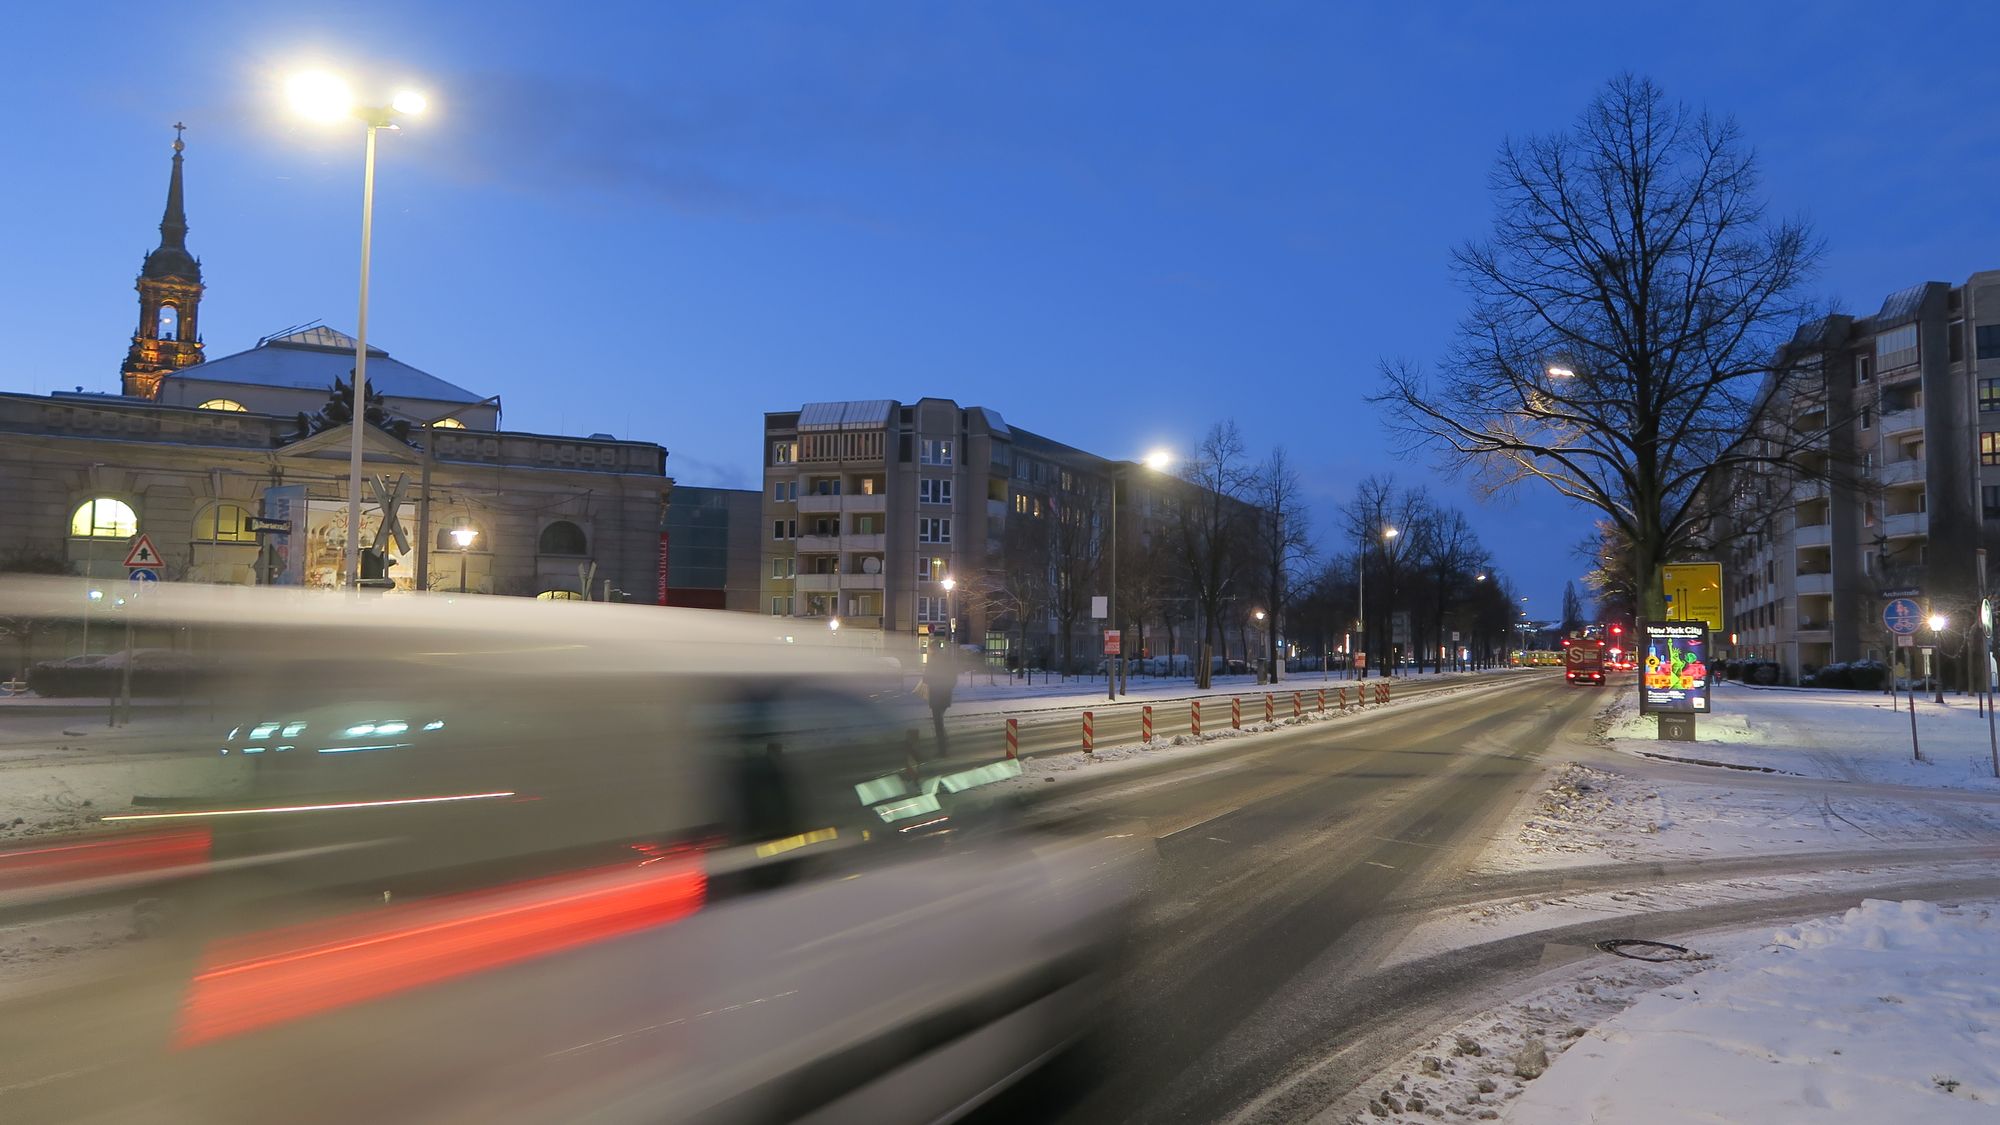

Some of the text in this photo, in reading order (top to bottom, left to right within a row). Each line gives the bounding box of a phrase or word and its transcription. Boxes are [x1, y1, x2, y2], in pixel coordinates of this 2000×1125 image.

[658, 539, 668, 601] MARKTHALLE
[1647, 626, 1703, 635] New York City
